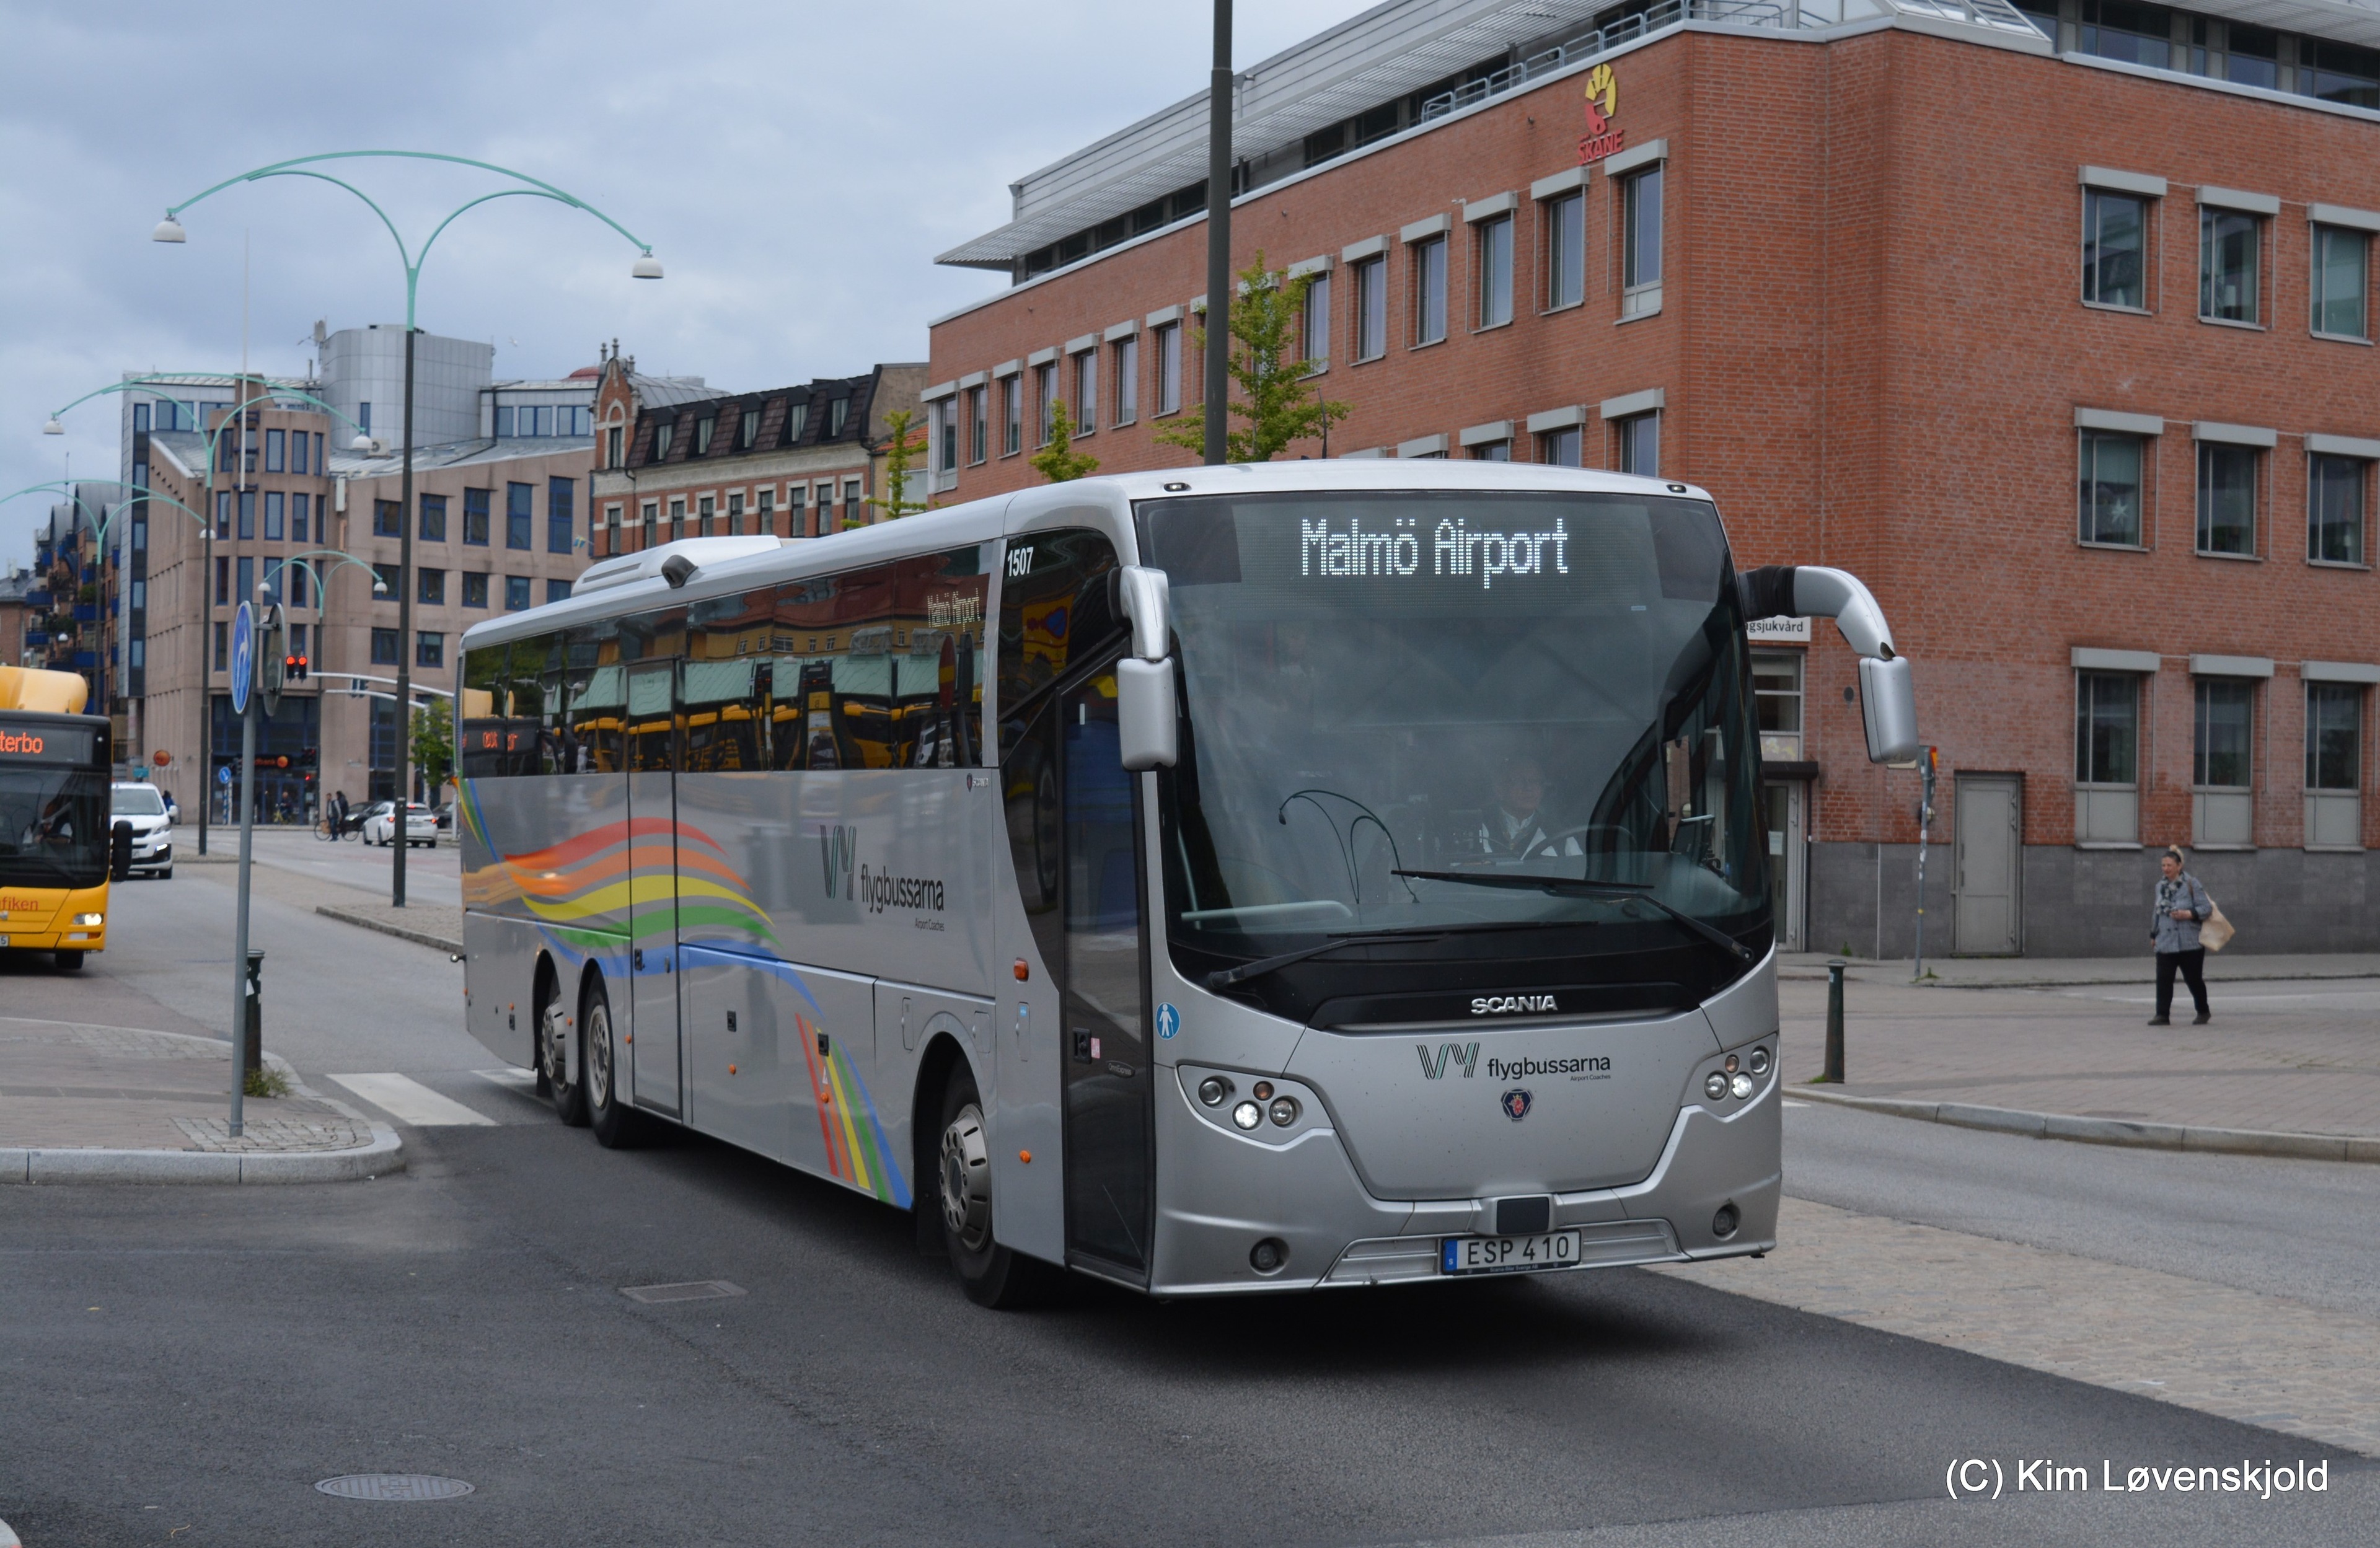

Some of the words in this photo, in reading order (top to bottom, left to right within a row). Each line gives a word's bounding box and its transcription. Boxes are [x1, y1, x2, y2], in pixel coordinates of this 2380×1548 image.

[1008, 547, 1034, 577] 1507
[1302, 519, 1418, 575] Malmö
[1435, 518, 1568, 589] Airport
[861, 863, 944, 914] flygbussarna
[0, 896, 38, 911] fiken
[1471, 995, 1558, 1014] SCANIA
[1487, 1056, 1611, 1081] flygbussarna
[1468, 1240, 1513, 1265] ESP
[1522, 1236, 1569, 1260] 410
